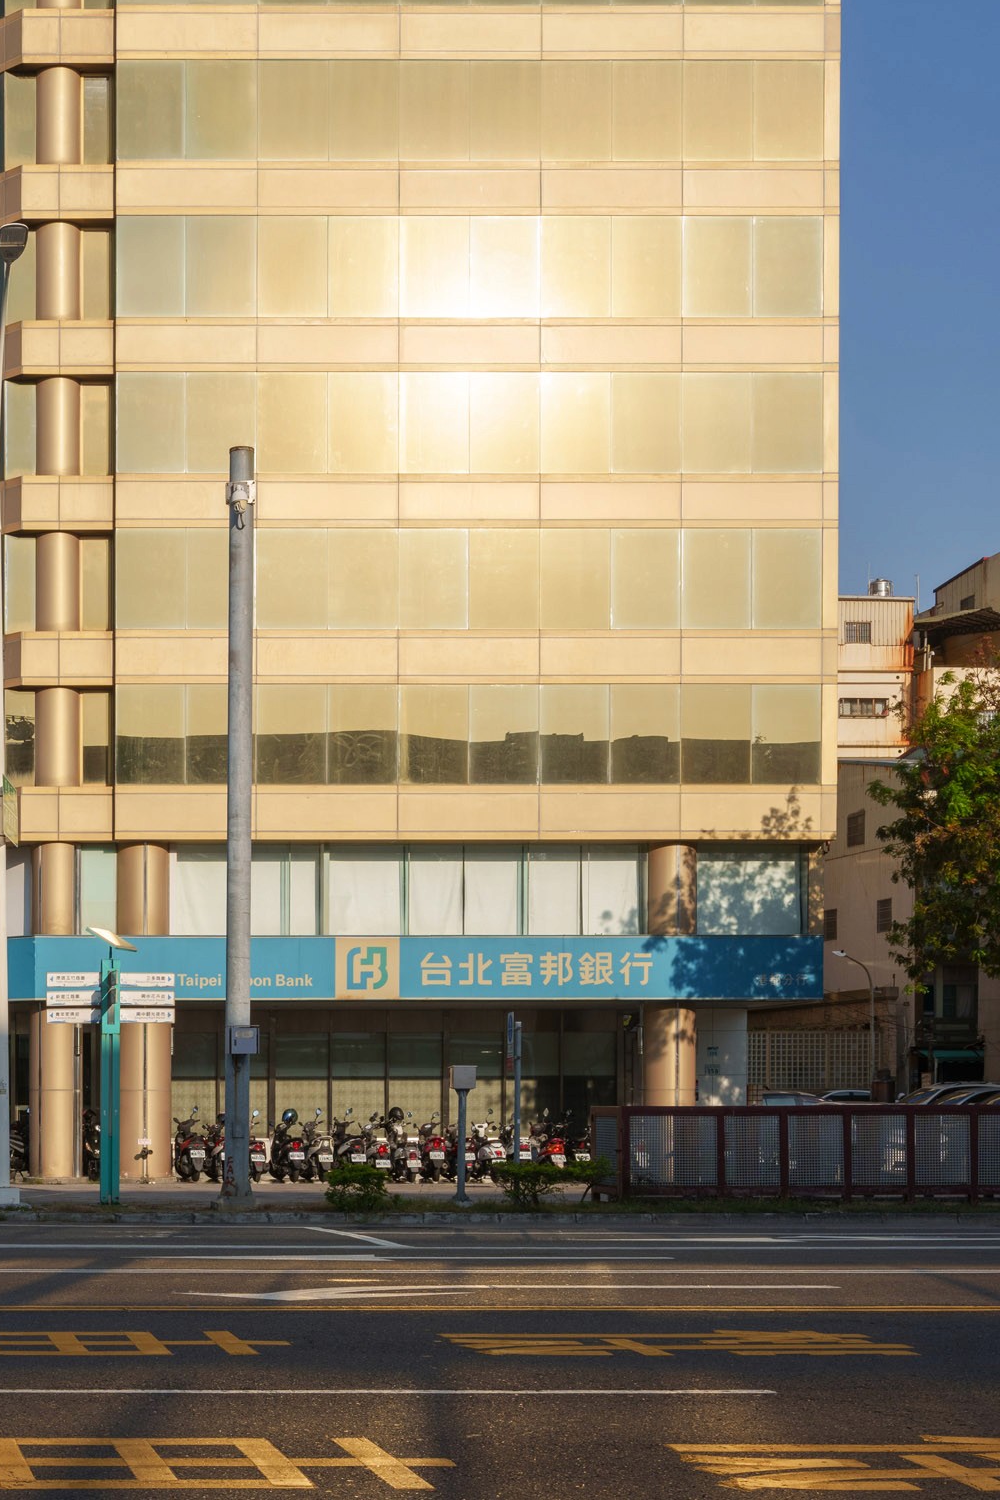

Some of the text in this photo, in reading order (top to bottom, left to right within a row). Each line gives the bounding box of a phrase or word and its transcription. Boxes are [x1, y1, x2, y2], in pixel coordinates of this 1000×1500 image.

[178, 973, 222, 989] Taipei
[275, 973, 313, 987] Bank
[420, 952, 654, 987] 台北富邦銀行
